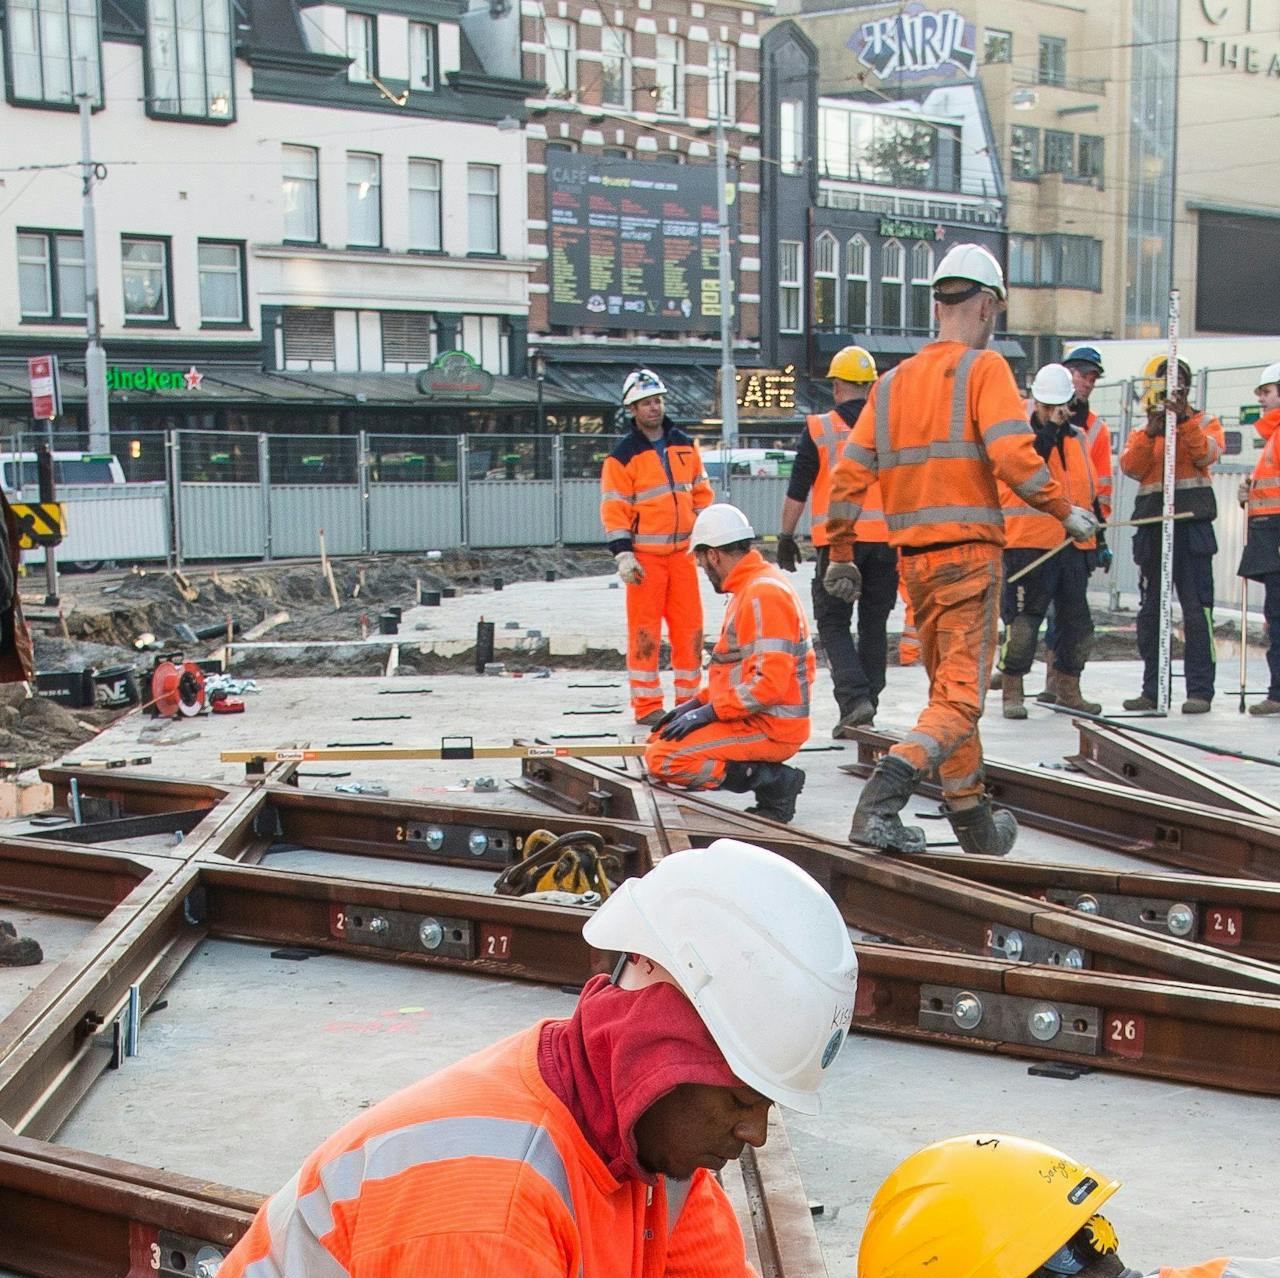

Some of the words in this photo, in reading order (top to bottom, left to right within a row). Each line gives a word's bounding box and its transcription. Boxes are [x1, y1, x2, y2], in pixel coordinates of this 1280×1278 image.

[106, 365, 184, 390] eineken
[735, 364, 795, 408] AFÉ
[1214, 913, 1237, 936] 24
[487, 935, 509, 955] 27
[1111, 1019, 1137, 1041] 26
[150, 1242, 161, 1270] 3
